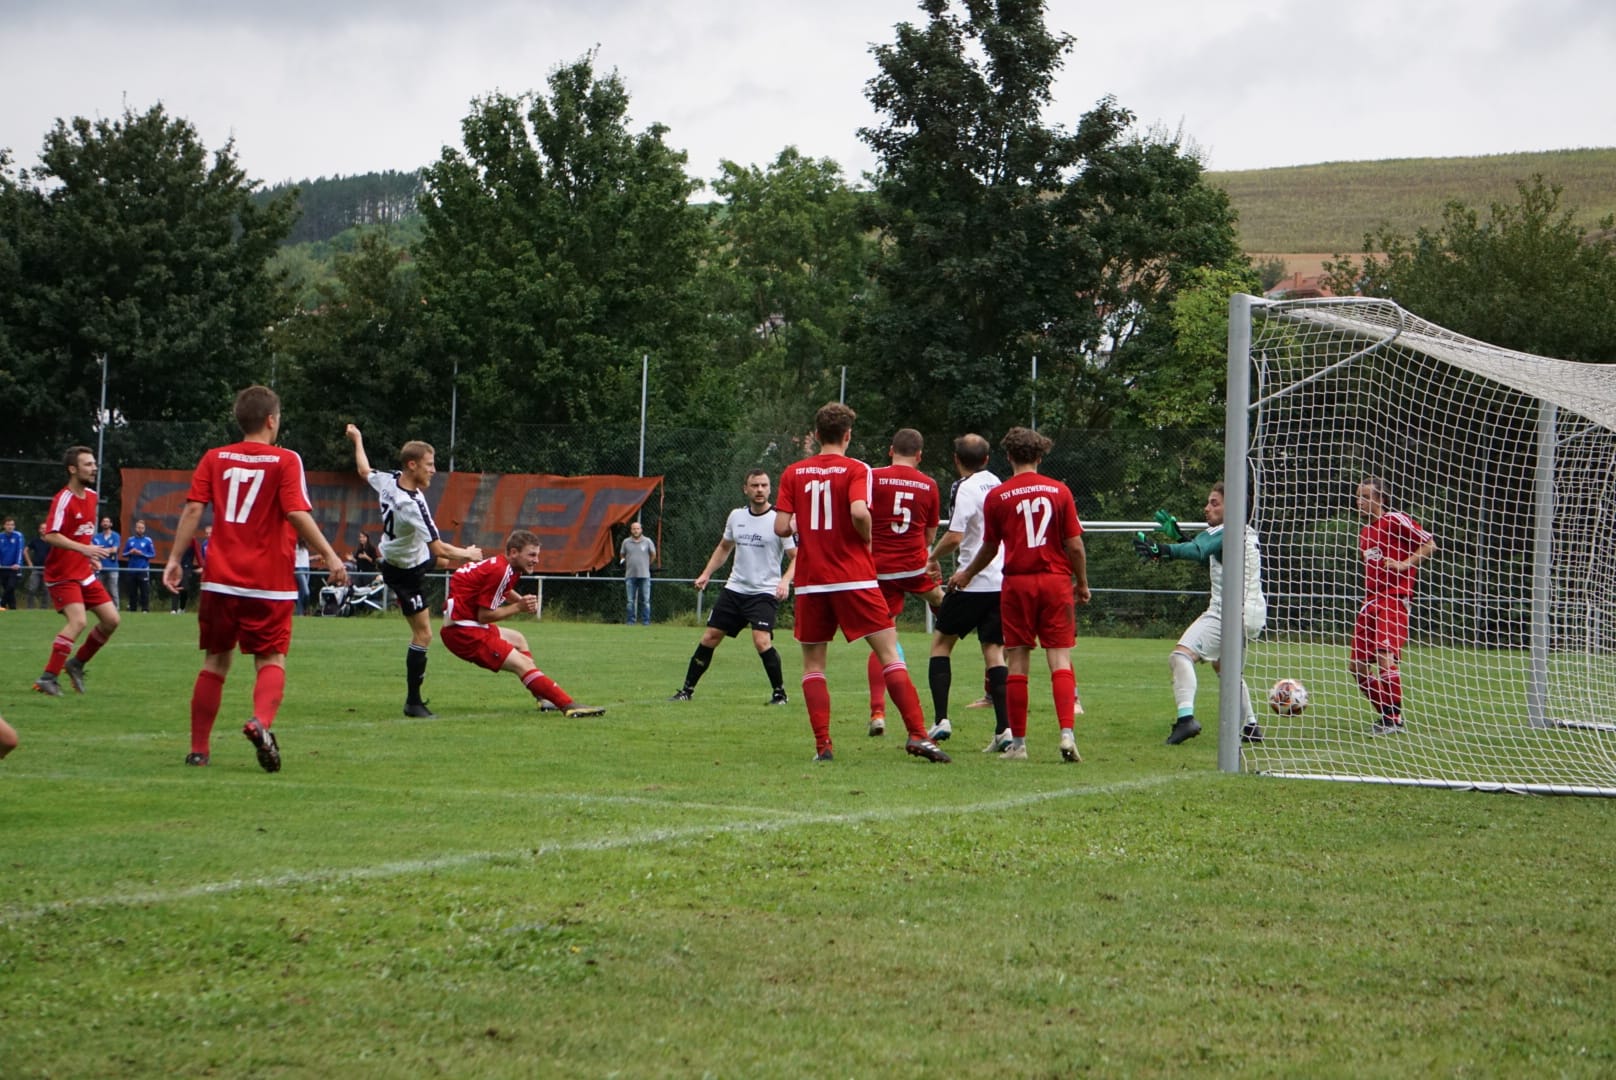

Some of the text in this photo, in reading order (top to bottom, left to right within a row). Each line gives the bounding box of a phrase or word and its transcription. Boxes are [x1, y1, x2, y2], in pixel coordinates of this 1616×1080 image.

[222, 466, 265, 524] 17
[804, 479, 833, 531] 11
[879, 477, 889, 485] TSV
[999, 491, 1011, 501] TSV
[1011, 484, 1059, 497] KREUZWERTHEIM
[890, 490, 915, 534] 5
[1016, 496, 1053, 549] 12
